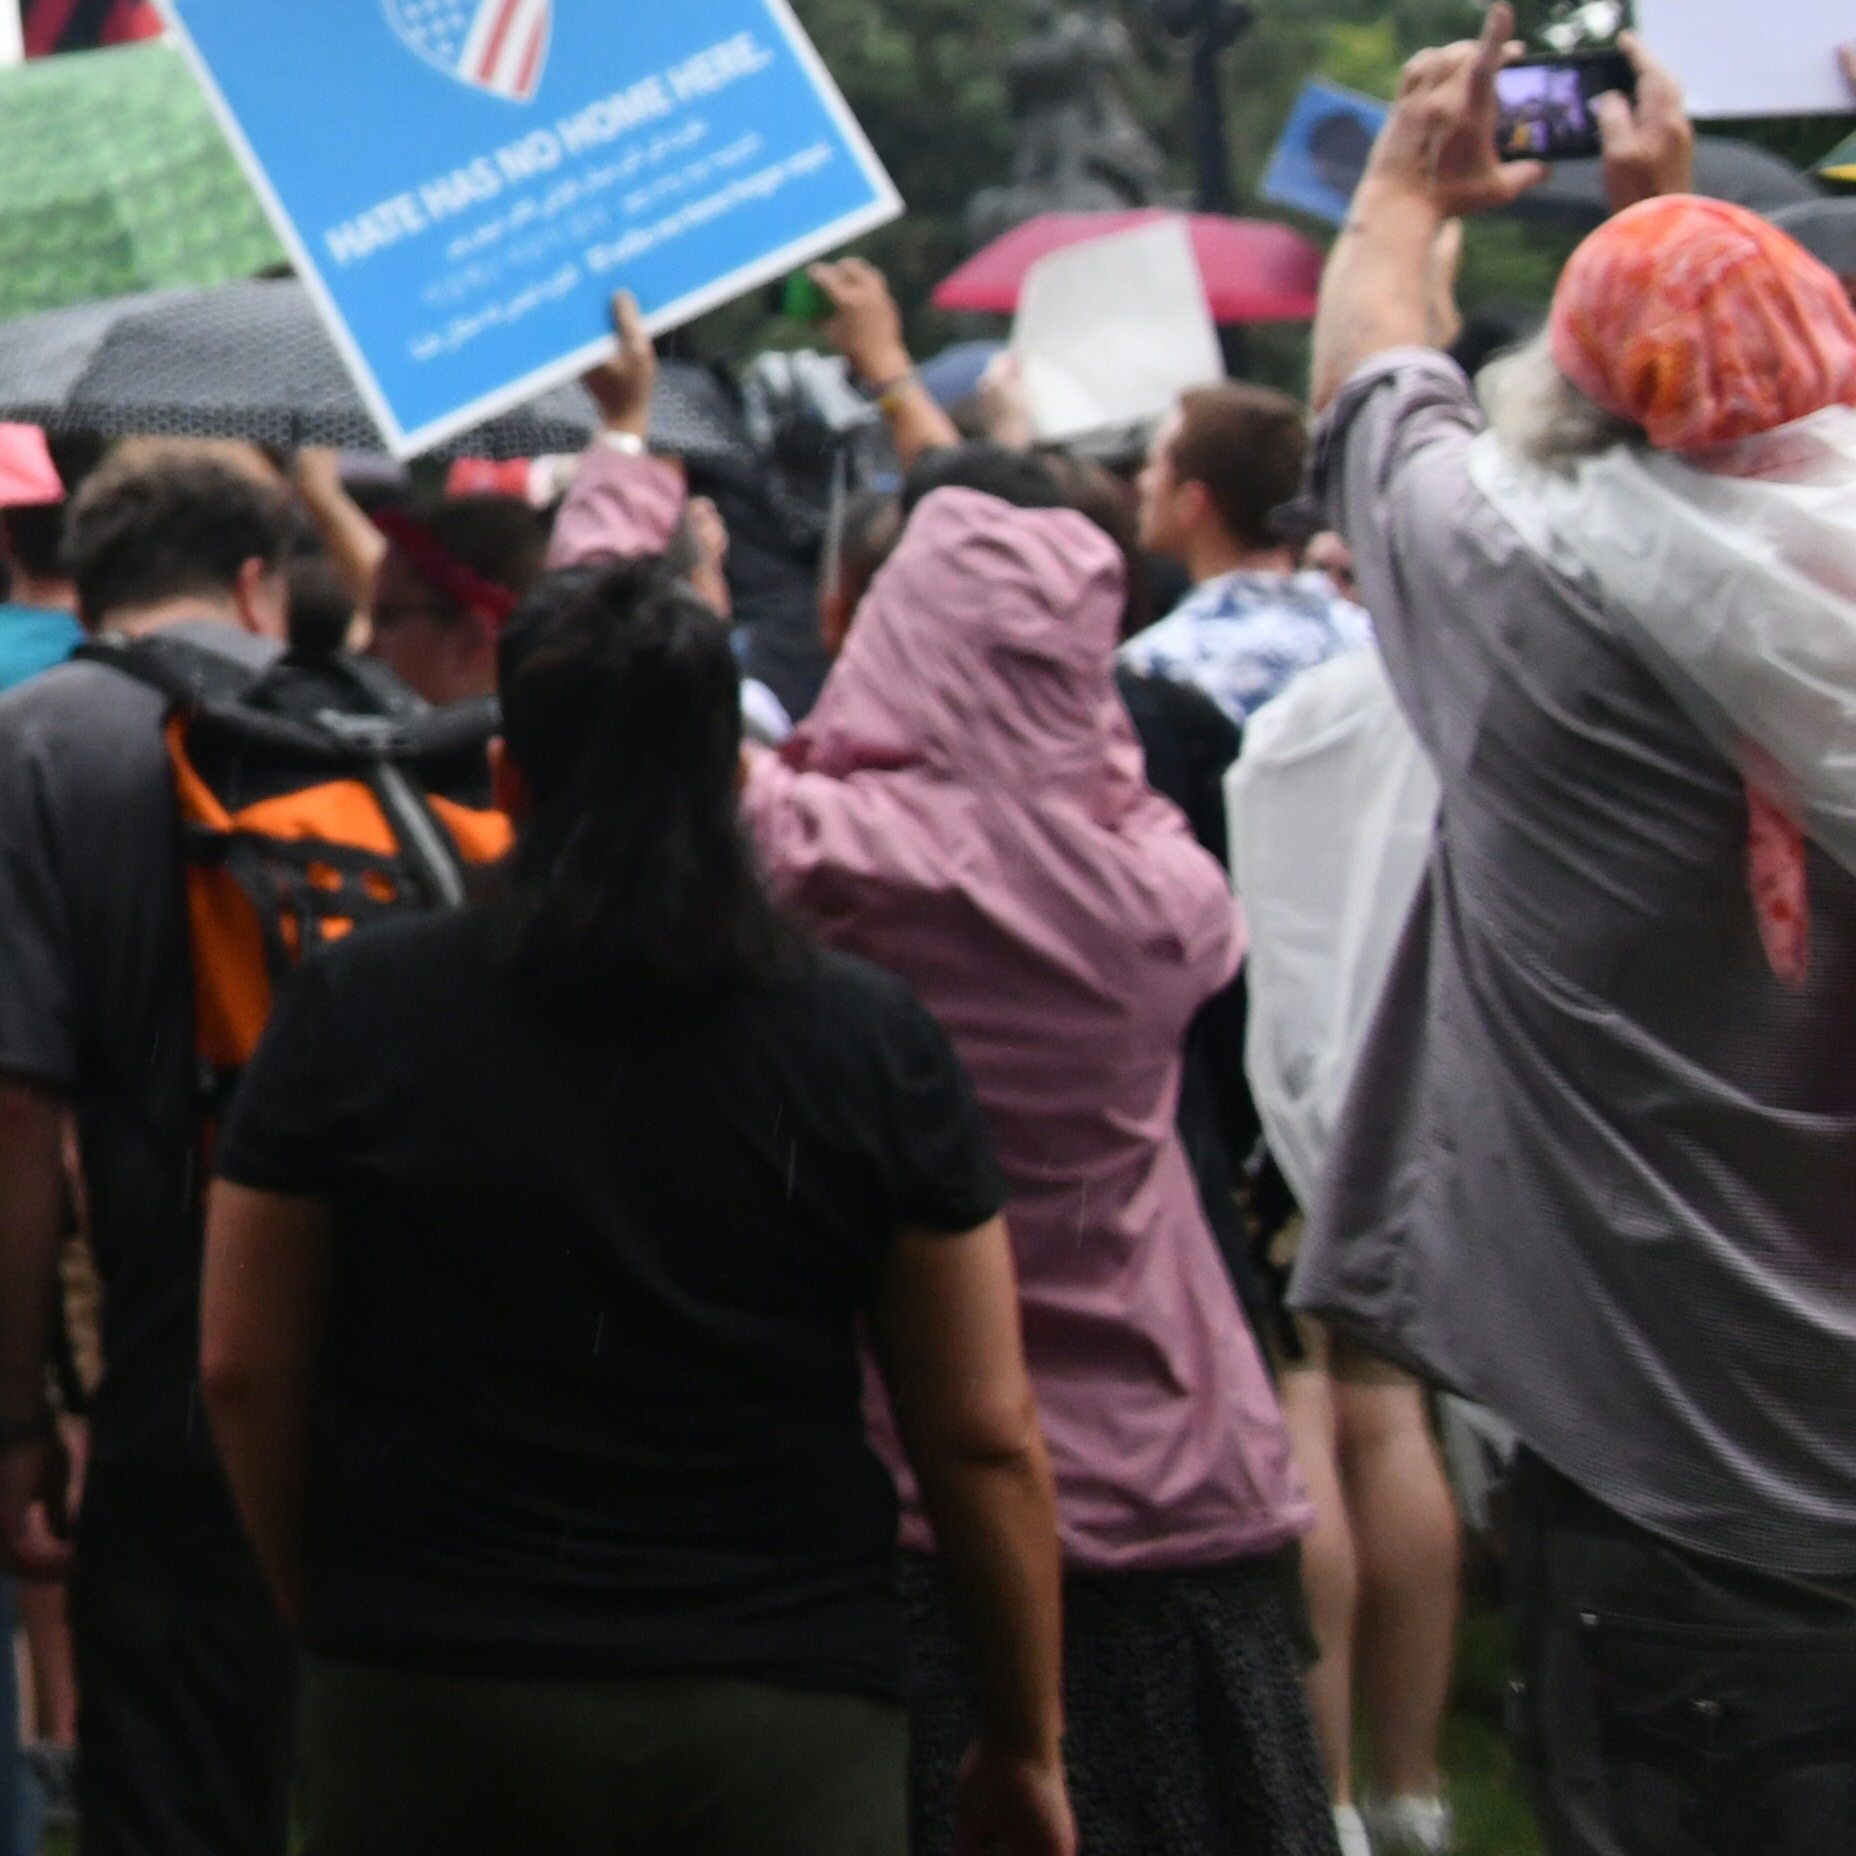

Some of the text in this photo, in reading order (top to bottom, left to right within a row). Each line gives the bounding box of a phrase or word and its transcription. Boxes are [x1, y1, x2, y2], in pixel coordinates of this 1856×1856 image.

[323, 191, 427, 266] HATE
[418, 154, 503, 221] HAS
[496, 128, 564, 185] NO
[557, 74, 673, 154] HOME
